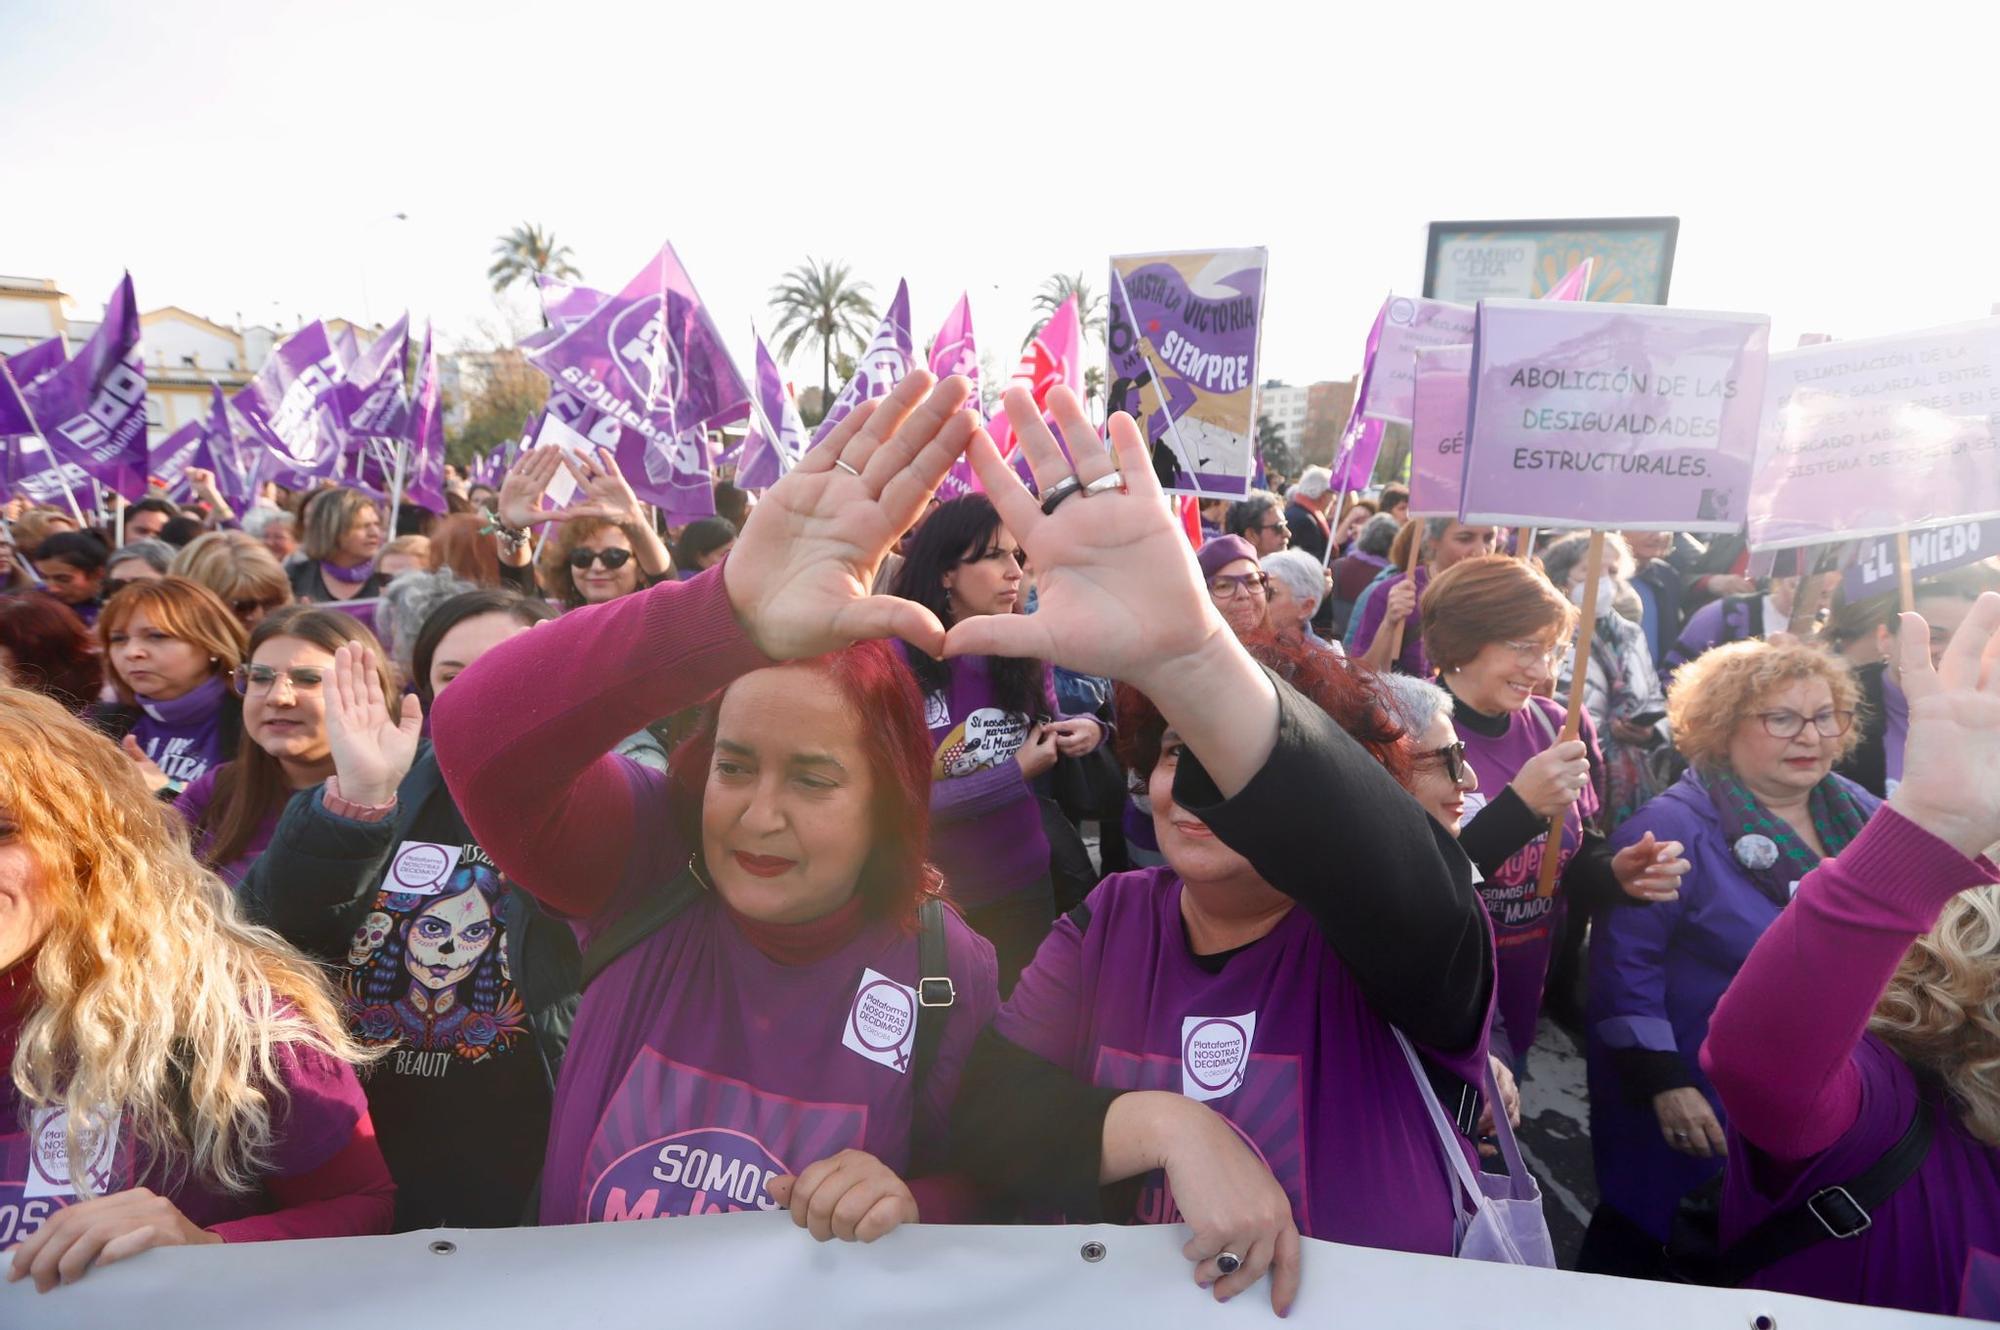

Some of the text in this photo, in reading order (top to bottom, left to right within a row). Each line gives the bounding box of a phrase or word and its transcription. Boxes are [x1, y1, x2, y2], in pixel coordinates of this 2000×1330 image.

[1126, 273, 1168, 303] HASTA
[1183, 293, 1255, 334] VICTORIA
[1159, 330, 1249, 391] SIEMPRE
[1920, 348, 1941, 365] DE
[1947, 345, 1968, 360] LA
[1510, 366, 1739, 399] ABOLICIÓN DE LAS
[1850, 363, 1993, 397] SALARIAL ENTRE
[1522, 408, 1719, 438] DESIGUALDADES
[1512, 448, 1713, 478] ESTRUCTURALES.
[1786, 456, 1863, 479] SISTEMA
[1869, 452, 1891, 467] DE
[1504, 897, 1554, 924] MUNDO
[862, 1002, 906, 1028] NOSOTRAS
[865, 993, 909, 1019] Plataforma
[859, 1010, 903, 1036] DECIDIMOS
[1193, 1039, 1240, 1049] Plataforma
[1194, 1046, 1240, 1059] NOSOTRAS
[395, 1050, 451, 1077] BEAUTY
[1194, 1055, 1239, 1069] DECIDIMOS
